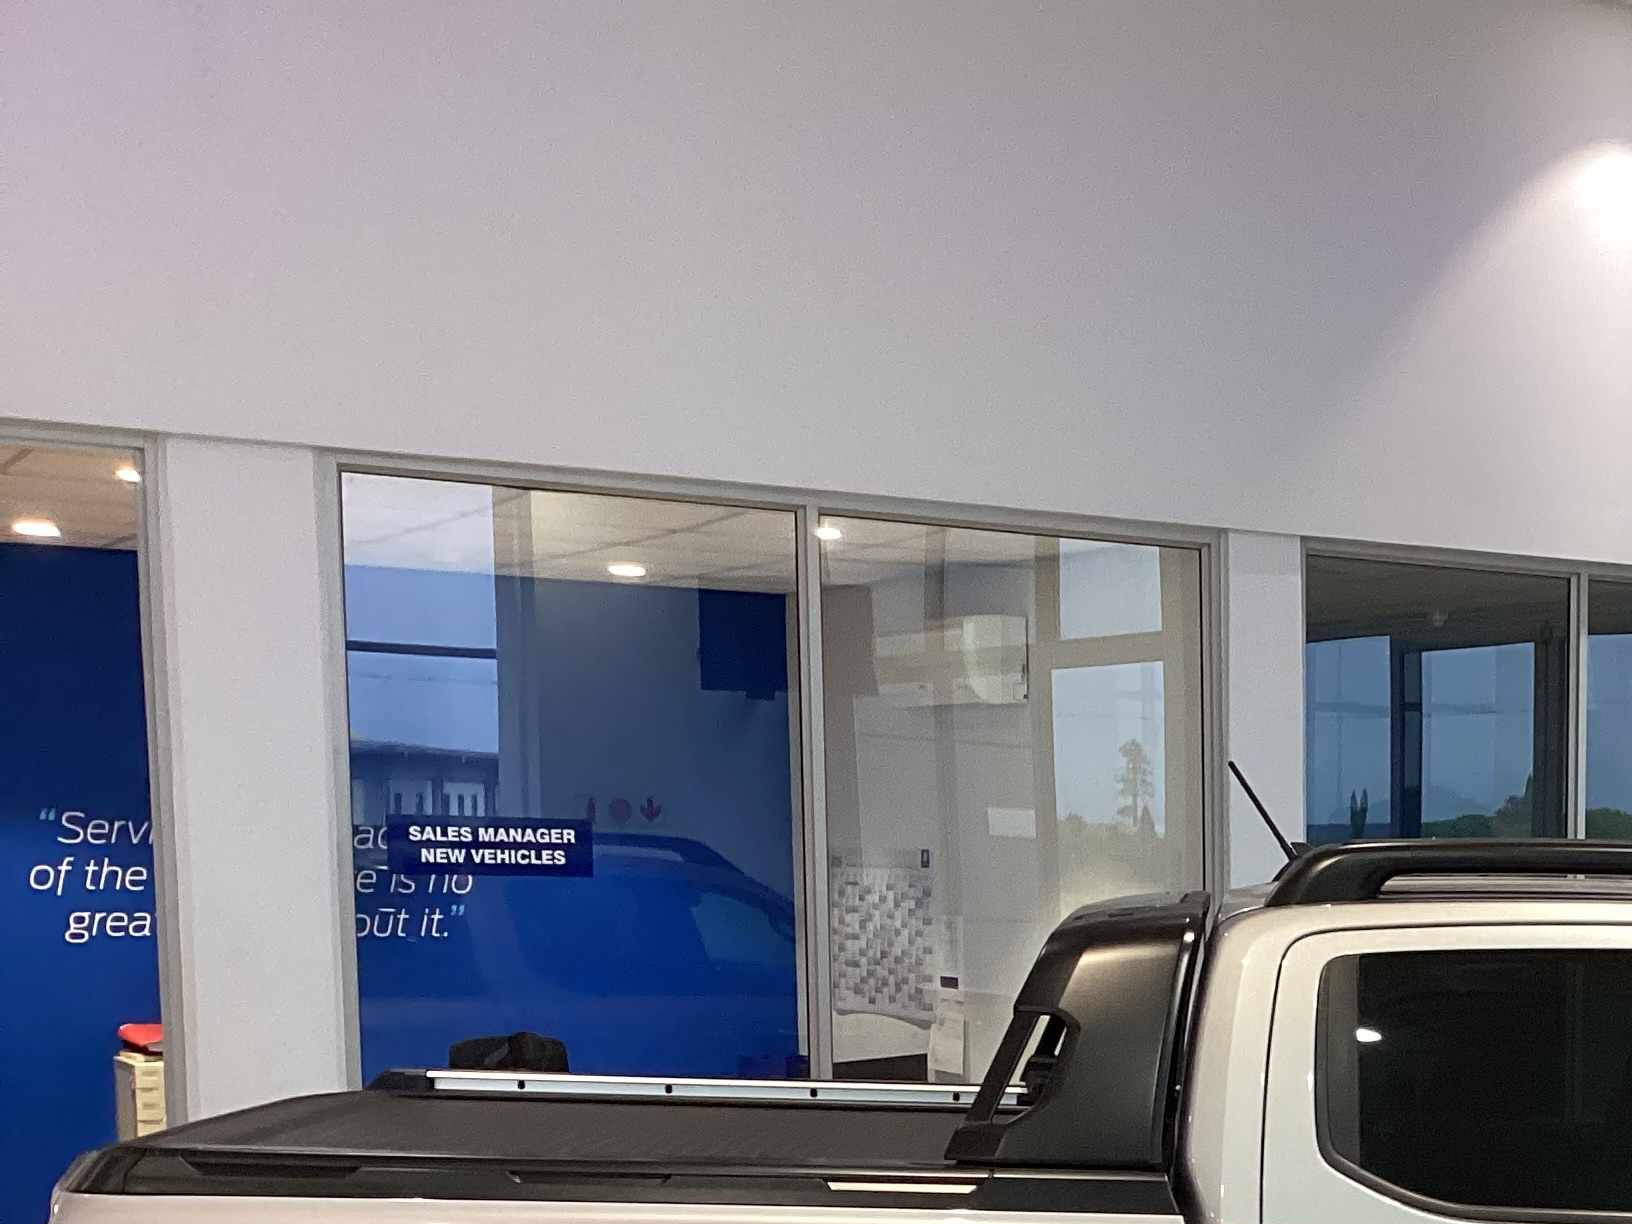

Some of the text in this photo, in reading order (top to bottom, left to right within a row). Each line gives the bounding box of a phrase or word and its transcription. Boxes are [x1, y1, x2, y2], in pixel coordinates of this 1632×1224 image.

[408, 825, 473, 842] SALES
[478, 827, 576, 844] MANAGER
[420, 848, 566, 865] NEW VEHICLES
[29, 857, 74, 896] of
[84, 857, 148, 891] the
[64, 911, 152, 944] grea
